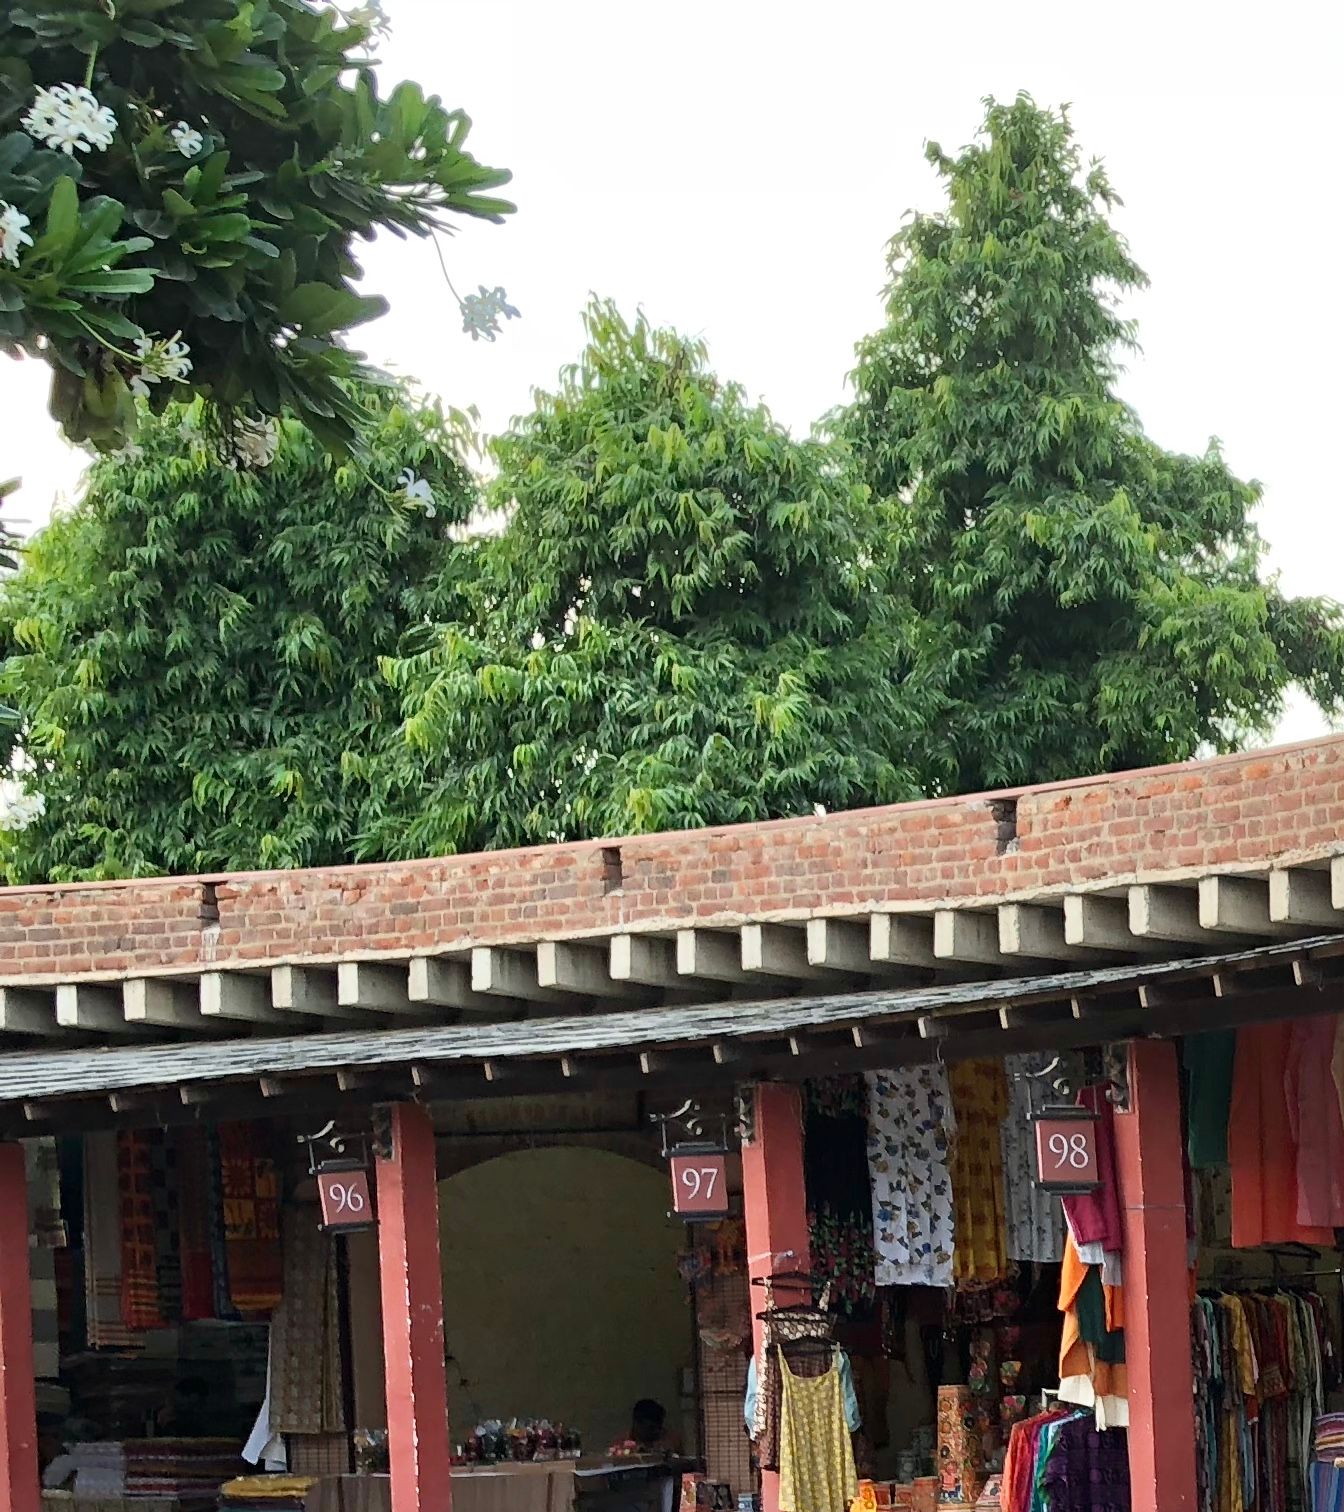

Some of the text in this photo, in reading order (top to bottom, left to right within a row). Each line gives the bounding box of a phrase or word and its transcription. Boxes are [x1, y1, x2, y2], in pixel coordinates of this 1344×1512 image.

[1048, 1133, 1090, 1168] 98
[329, 1182, 364, 1213] 96
[682, 1167, 719, 1200] 97
